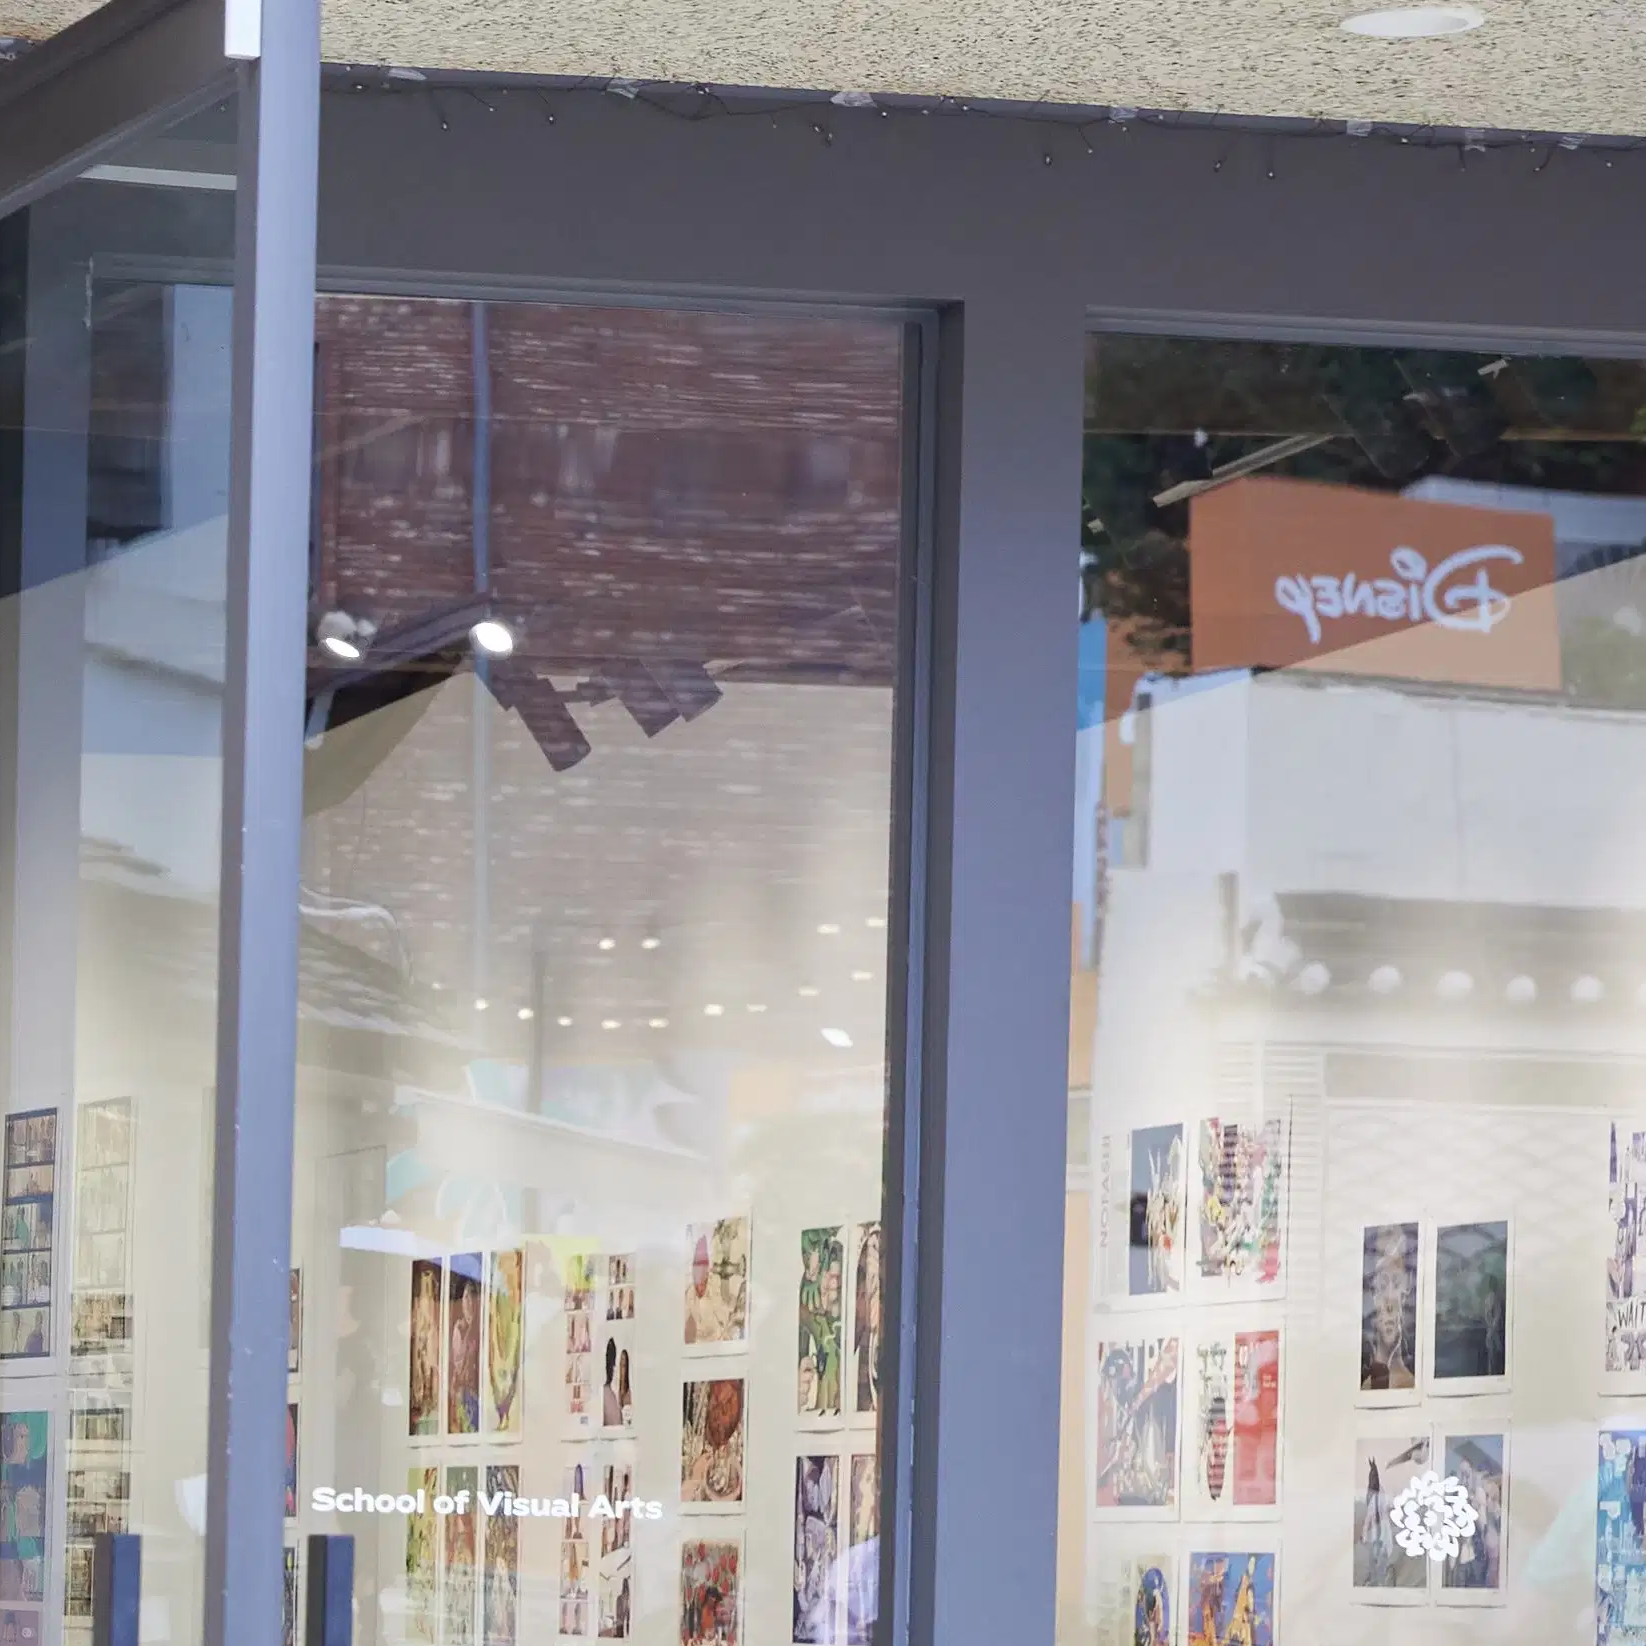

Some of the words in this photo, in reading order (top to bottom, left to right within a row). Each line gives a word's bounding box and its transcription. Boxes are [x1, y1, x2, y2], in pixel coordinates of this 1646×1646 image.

[311, 1486, 425, 1514] School
[433, 1490, 470, 1515] of
[477, 1491, 579, 1519] Visual
[588, 1494, 663, 1520] Arts
